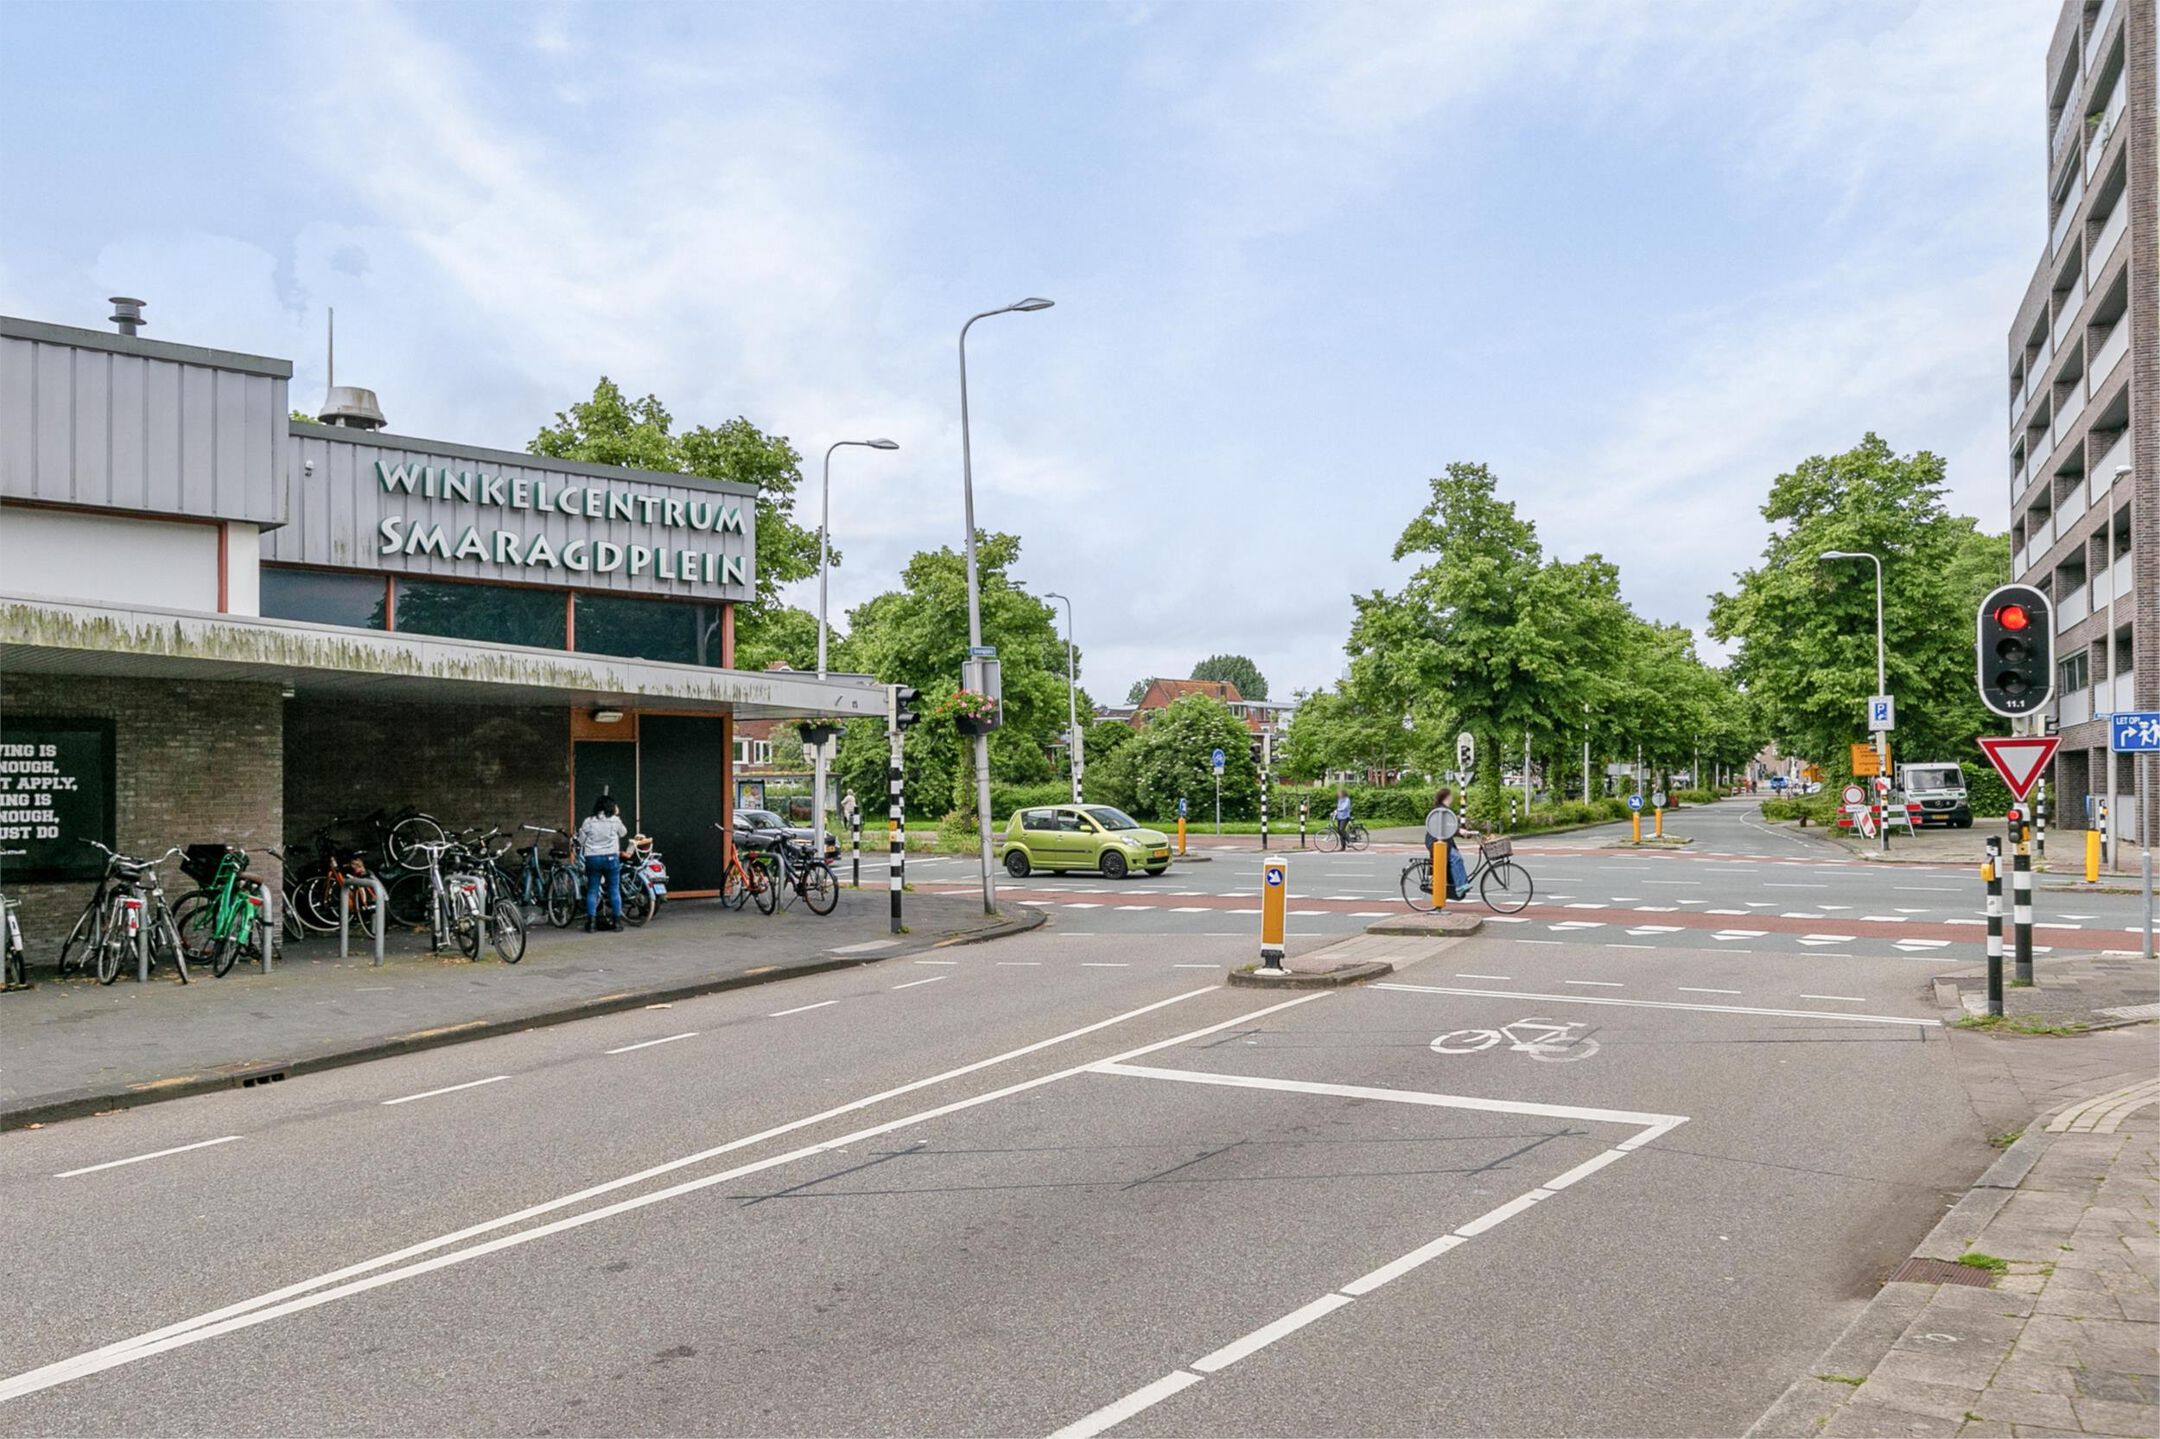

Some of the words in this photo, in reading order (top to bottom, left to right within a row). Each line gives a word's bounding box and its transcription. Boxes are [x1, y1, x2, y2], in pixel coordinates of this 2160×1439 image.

[375, 460, 748, 536] WINKELCENTRUM
[380, 515, 747, 586] SMARAGDPLEIN
[2006, 700, 2025, 708] 11.1
[2116, 716, 2128, 725] LET
[39, 744, 57, 757] IS
[16, 777, 78, 791] APPLY,
[34, 793, 52, 806] IS
[36, 826, 59, 839] DO
